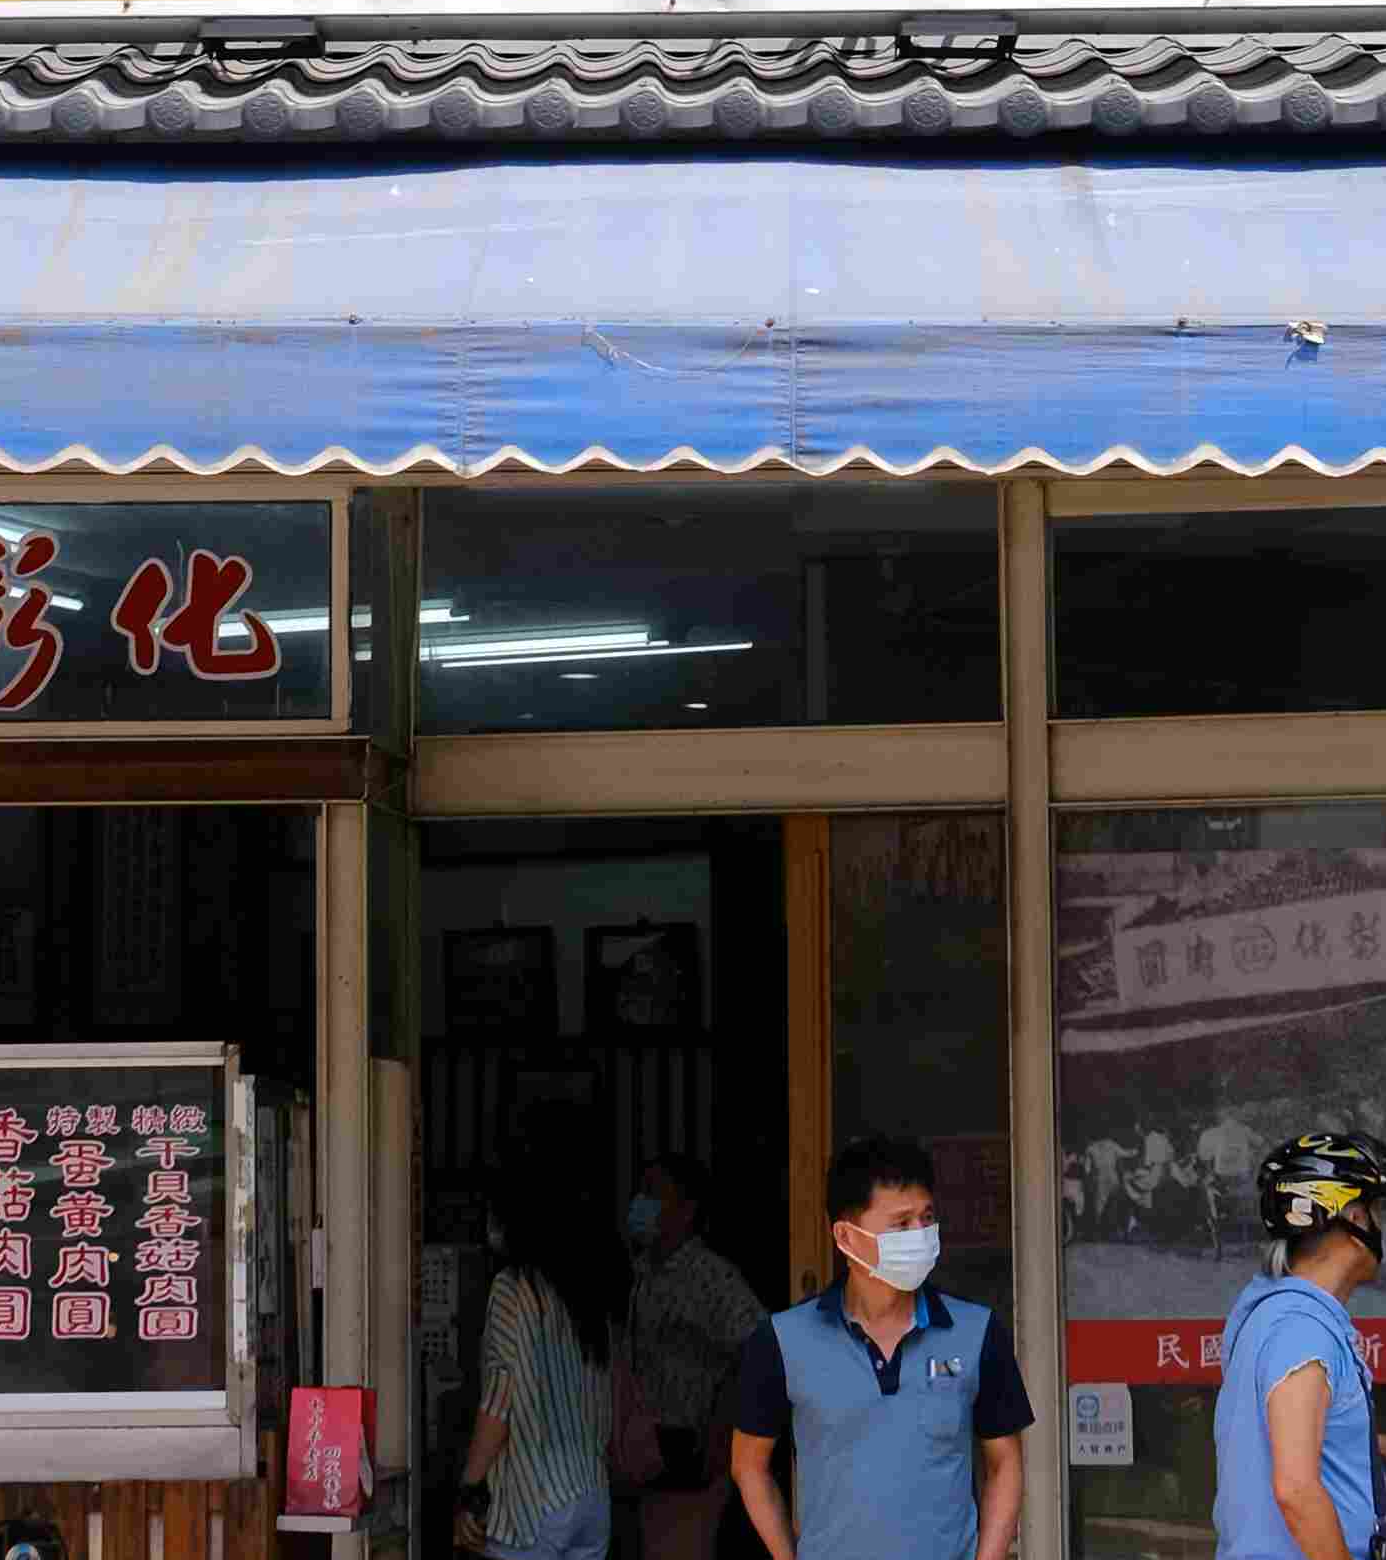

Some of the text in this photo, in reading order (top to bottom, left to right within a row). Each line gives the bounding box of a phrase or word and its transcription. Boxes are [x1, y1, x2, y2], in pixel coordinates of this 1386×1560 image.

[45, 1105, 120, 1137] 特製
[131, 1104, 208, 1136] 精緻
[48, 1139, 116, 1340] 蛋黃肉圓
[134, 1136, 201, 1341] 干貝香菇肉圓
